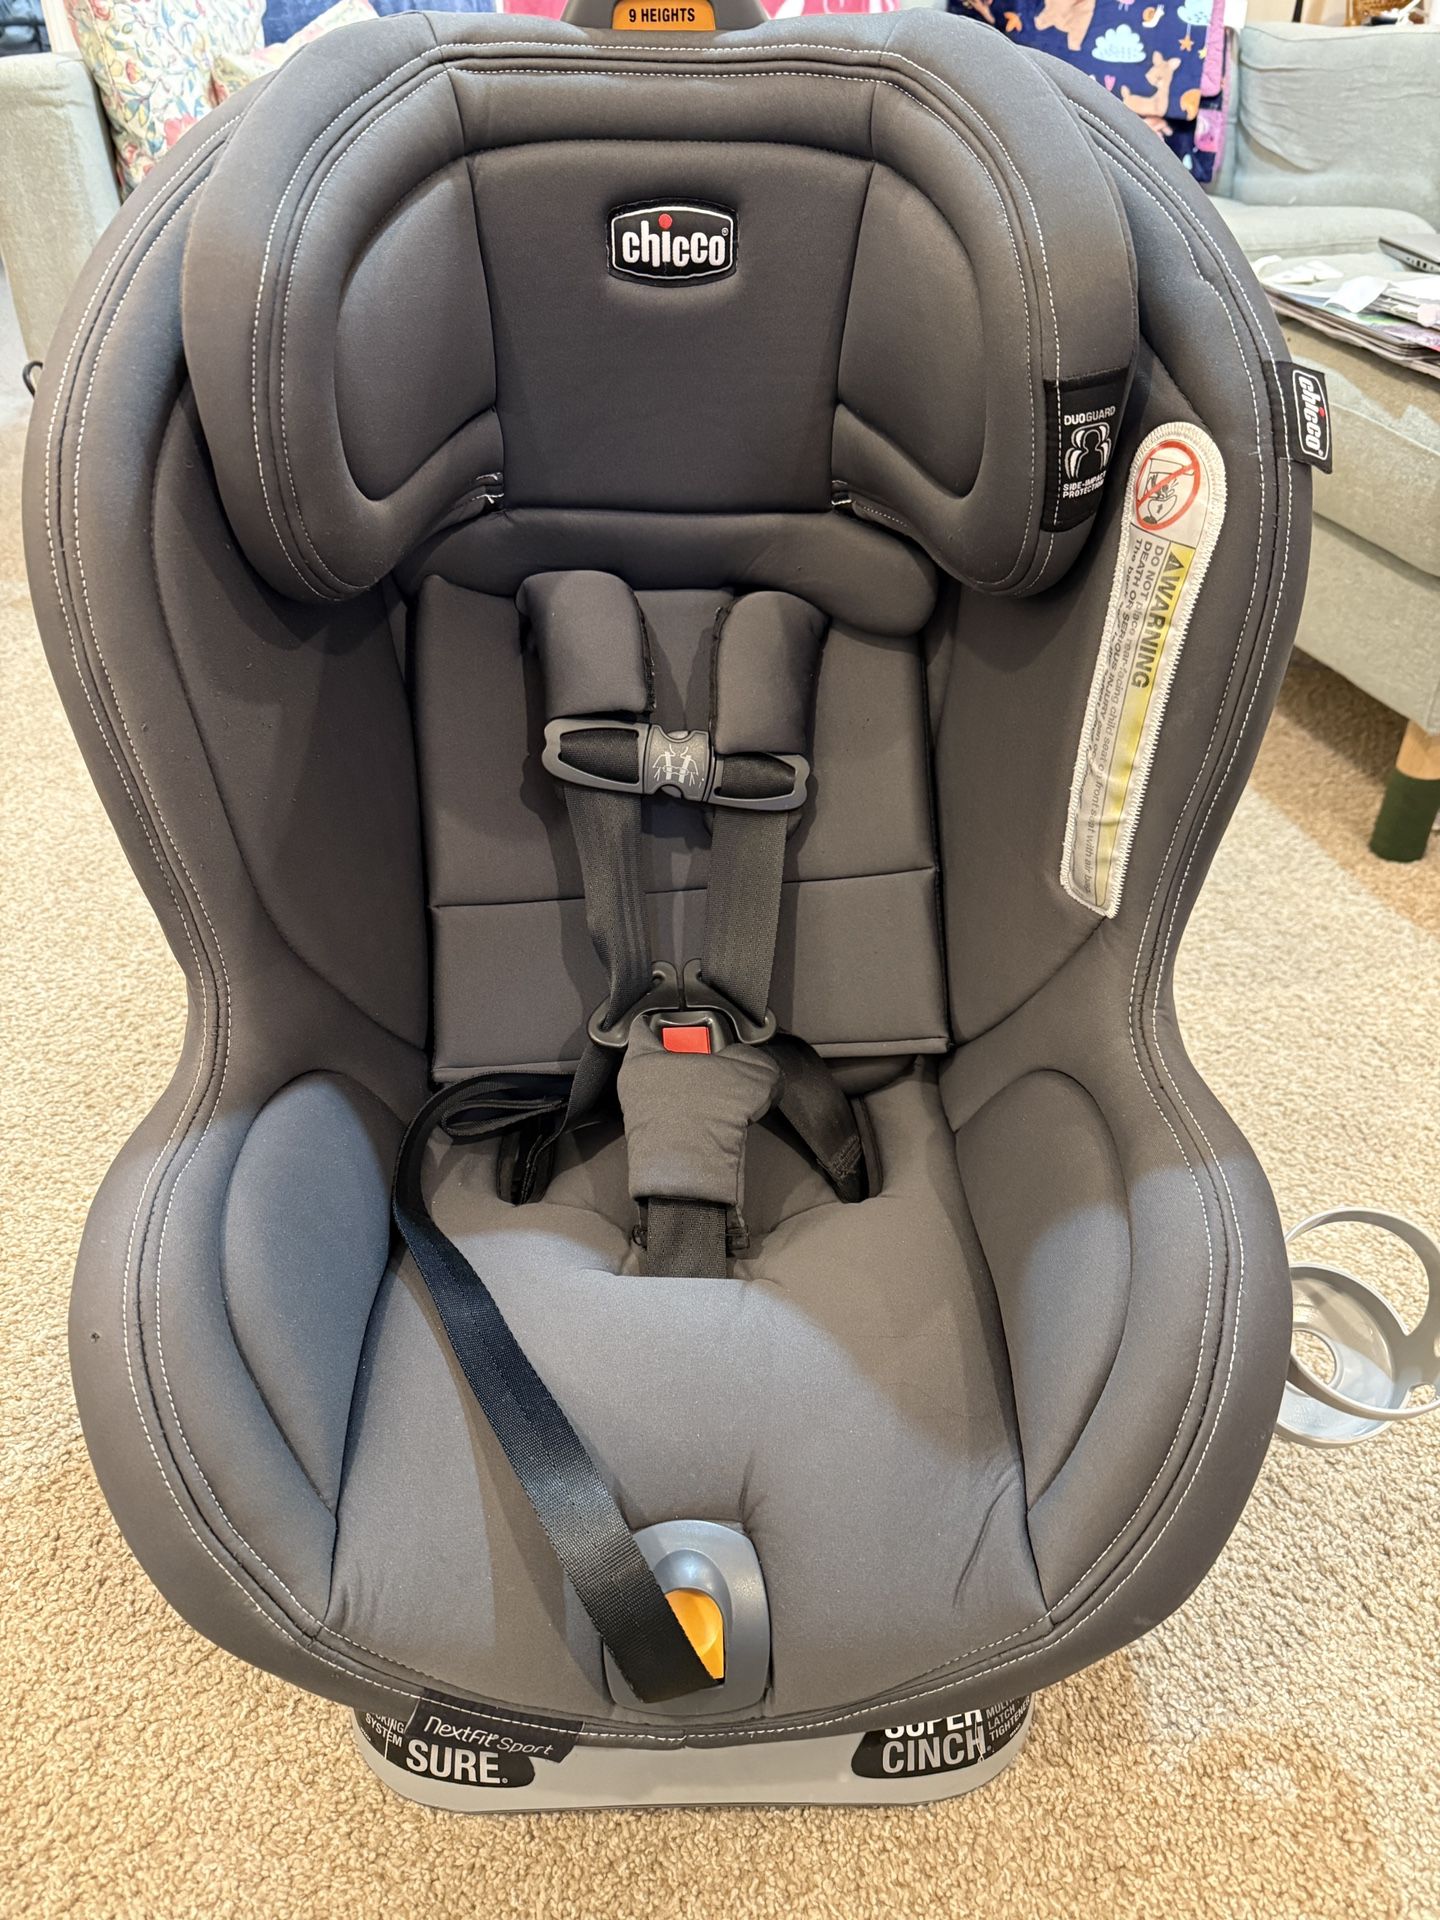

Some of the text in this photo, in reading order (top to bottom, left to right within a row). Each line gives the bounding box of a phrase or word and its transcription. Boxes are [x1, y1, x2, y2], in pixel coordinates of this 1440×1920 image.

[629, 8, 695, 22] 9 HEIGHTS
[1132, 540, 1152, 587] DEATH
[1149, 545, 1164, 567] DO
[1125, 589, 1137, 610] OR
[1139, 570, 1155, 600] NOT
[1111, 611, 1130, 671] SERIOUS
[1131, 576, 1180, 689] WARNING
[1099, 672, 1114, 719] INJURY
[1104, 706, 1118, 735] child
[1099, 736, 1111, 761] seat
[366, 1712, 403, 1748] SYSTEM
[988, 1703, 1016, 1731] LATCH
[989, 1695, 1030, 1742] TIGHTENER
[497, 1737, 554, 1756] Sport
[882, 1723, 987, 1774] CINCH
